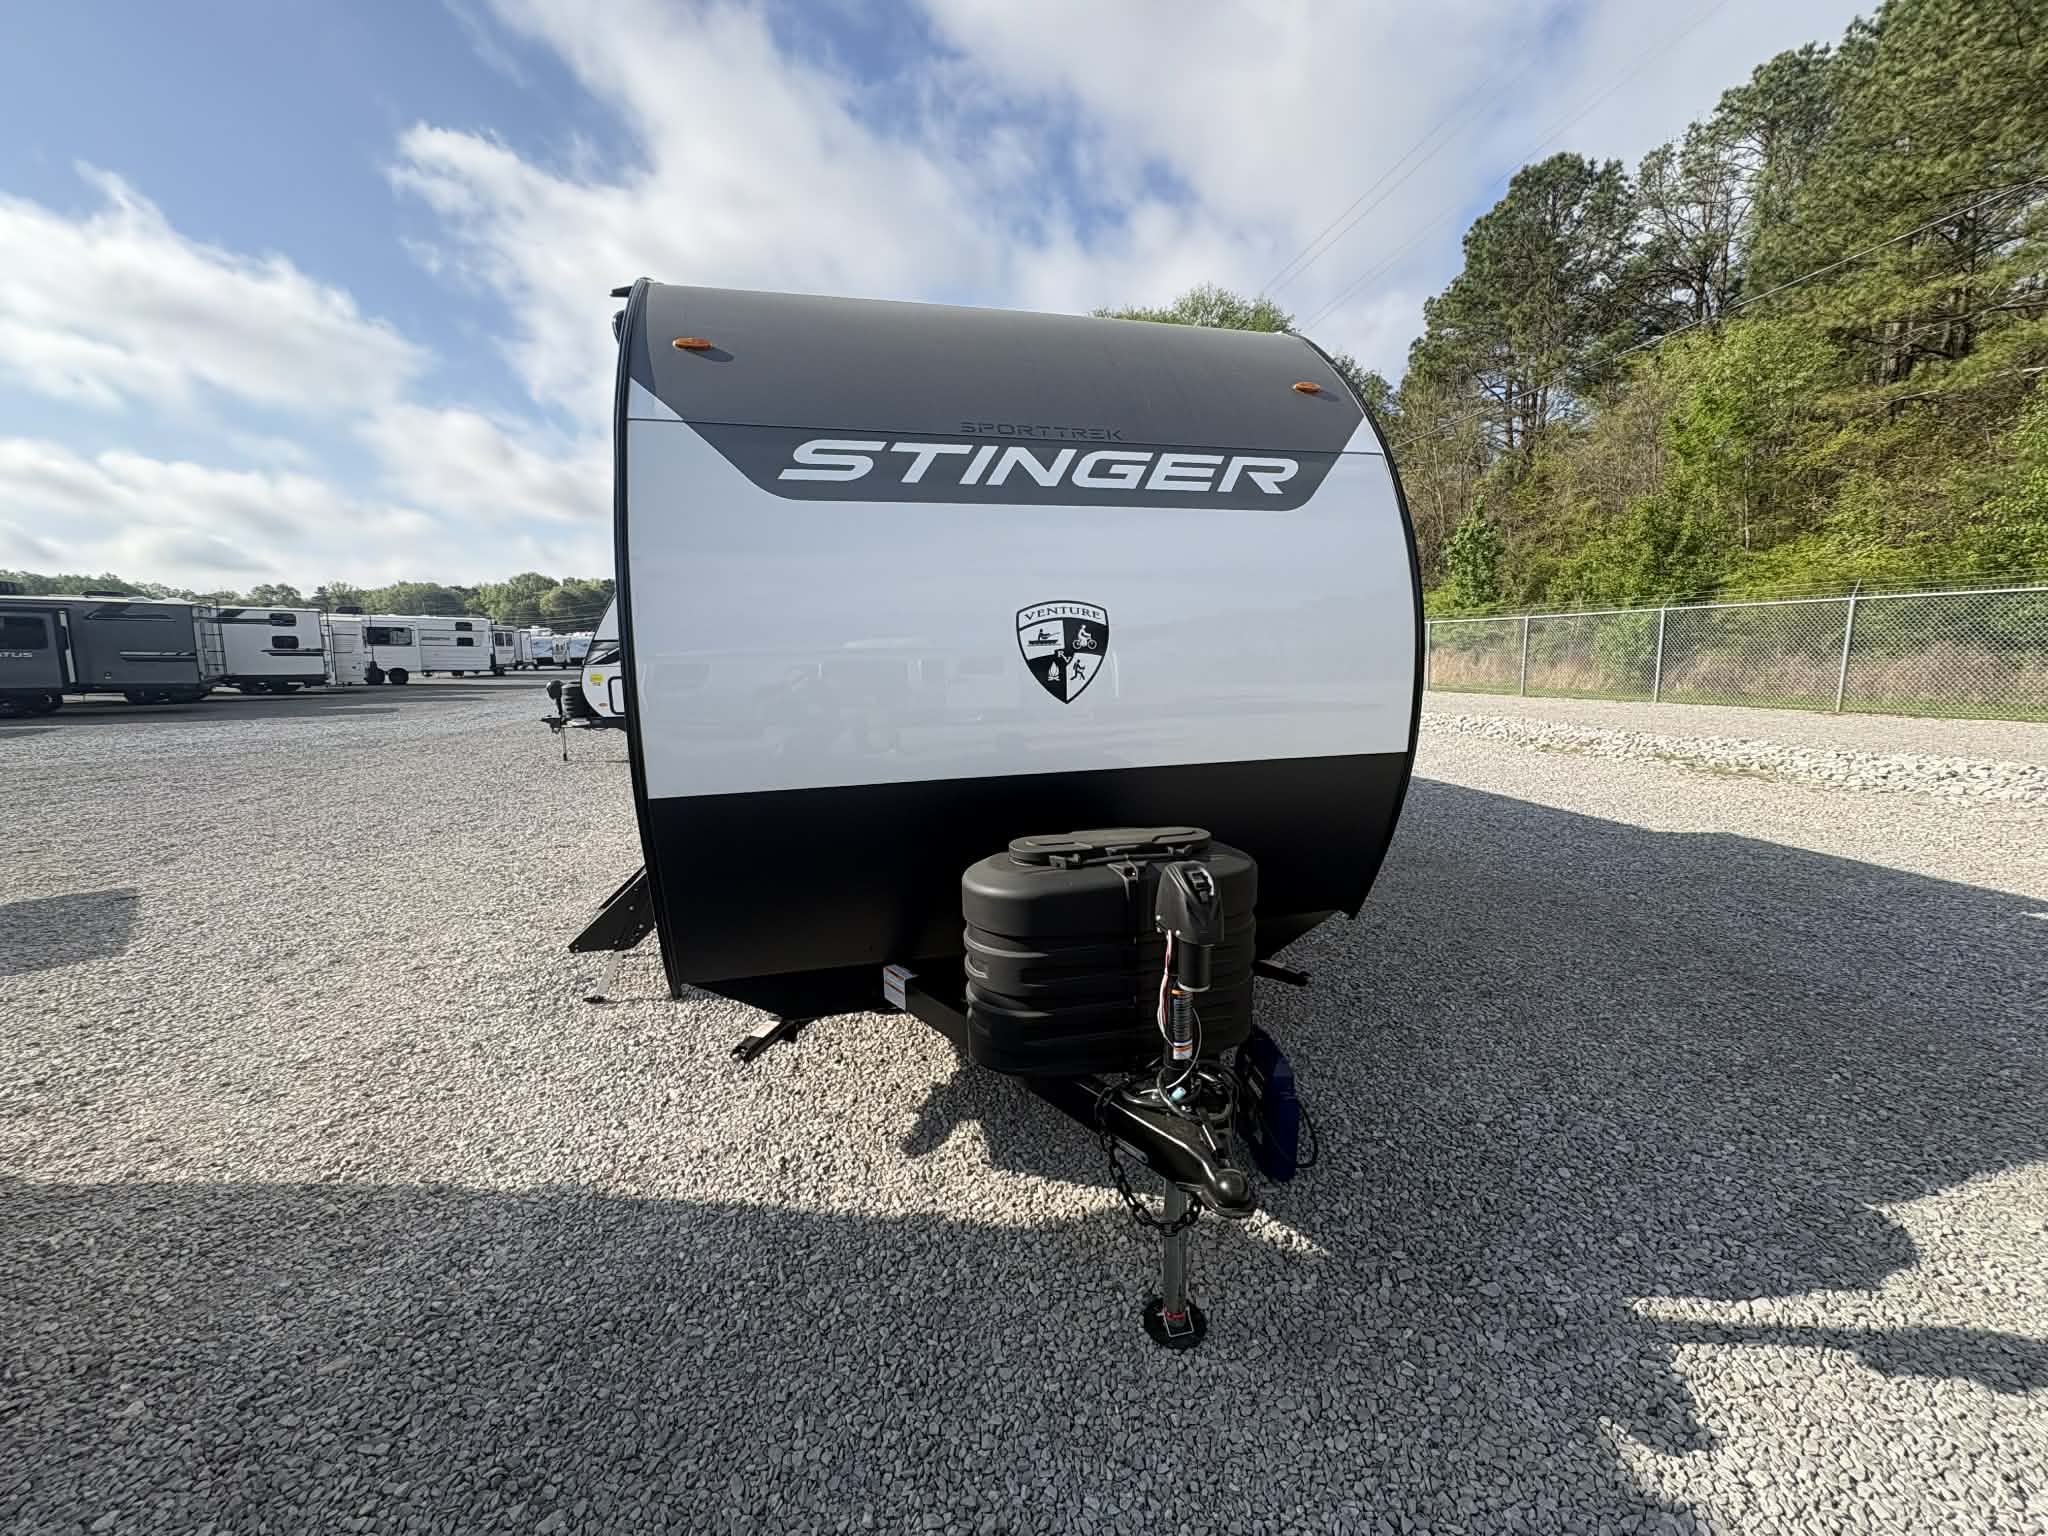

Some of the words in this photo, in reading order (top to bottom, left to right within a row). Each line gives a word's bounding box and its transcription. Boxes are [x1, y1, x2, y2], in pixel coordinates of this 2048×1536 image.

[960, 421, 1123, 440] SPORTTREK
[777, 439, 1299, 494] STINGER
[1024, 606, 1102, 620] VENTURE
[1057, 650, 1072, 663] RV
